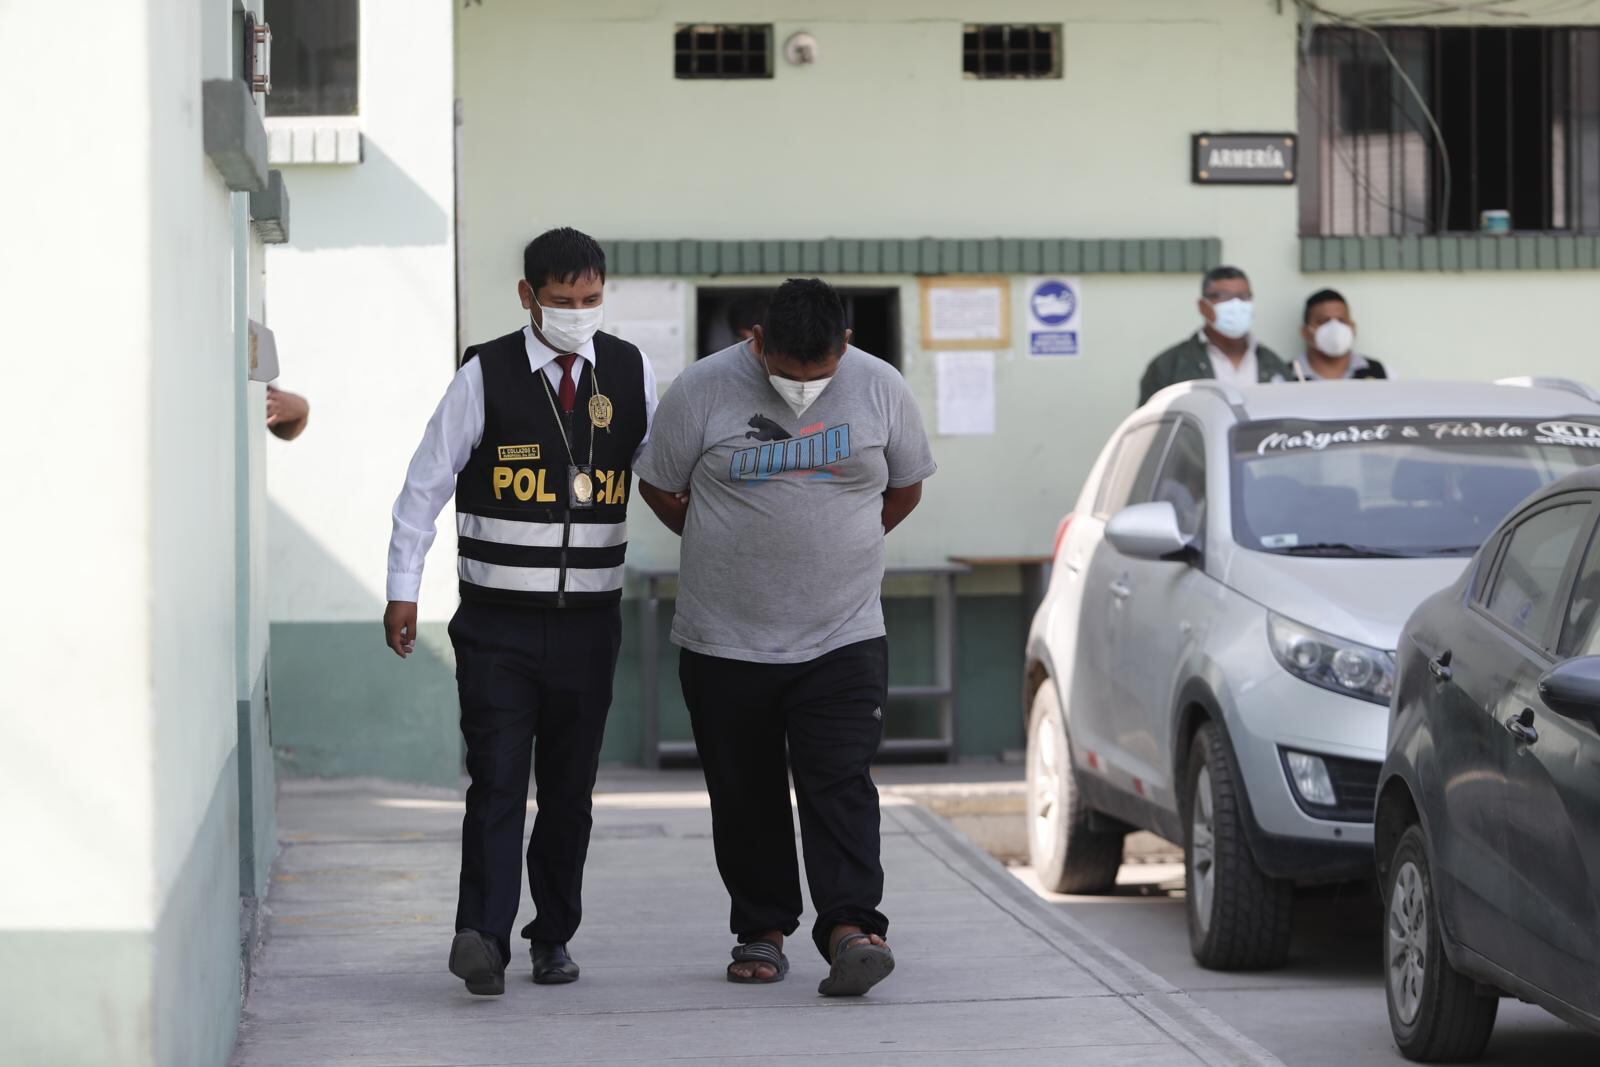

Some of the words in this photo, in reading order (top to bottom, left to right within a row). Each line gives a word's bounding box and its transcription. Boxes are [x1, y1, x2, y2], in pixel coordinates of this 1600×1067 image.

[1208, 144, 1284, 168] ARMERÍA
[730, 423, 850, 480] PUMA
[1257, 424, 1393, 455] Margaret
[493, 466, 625, 505] POLCIA
